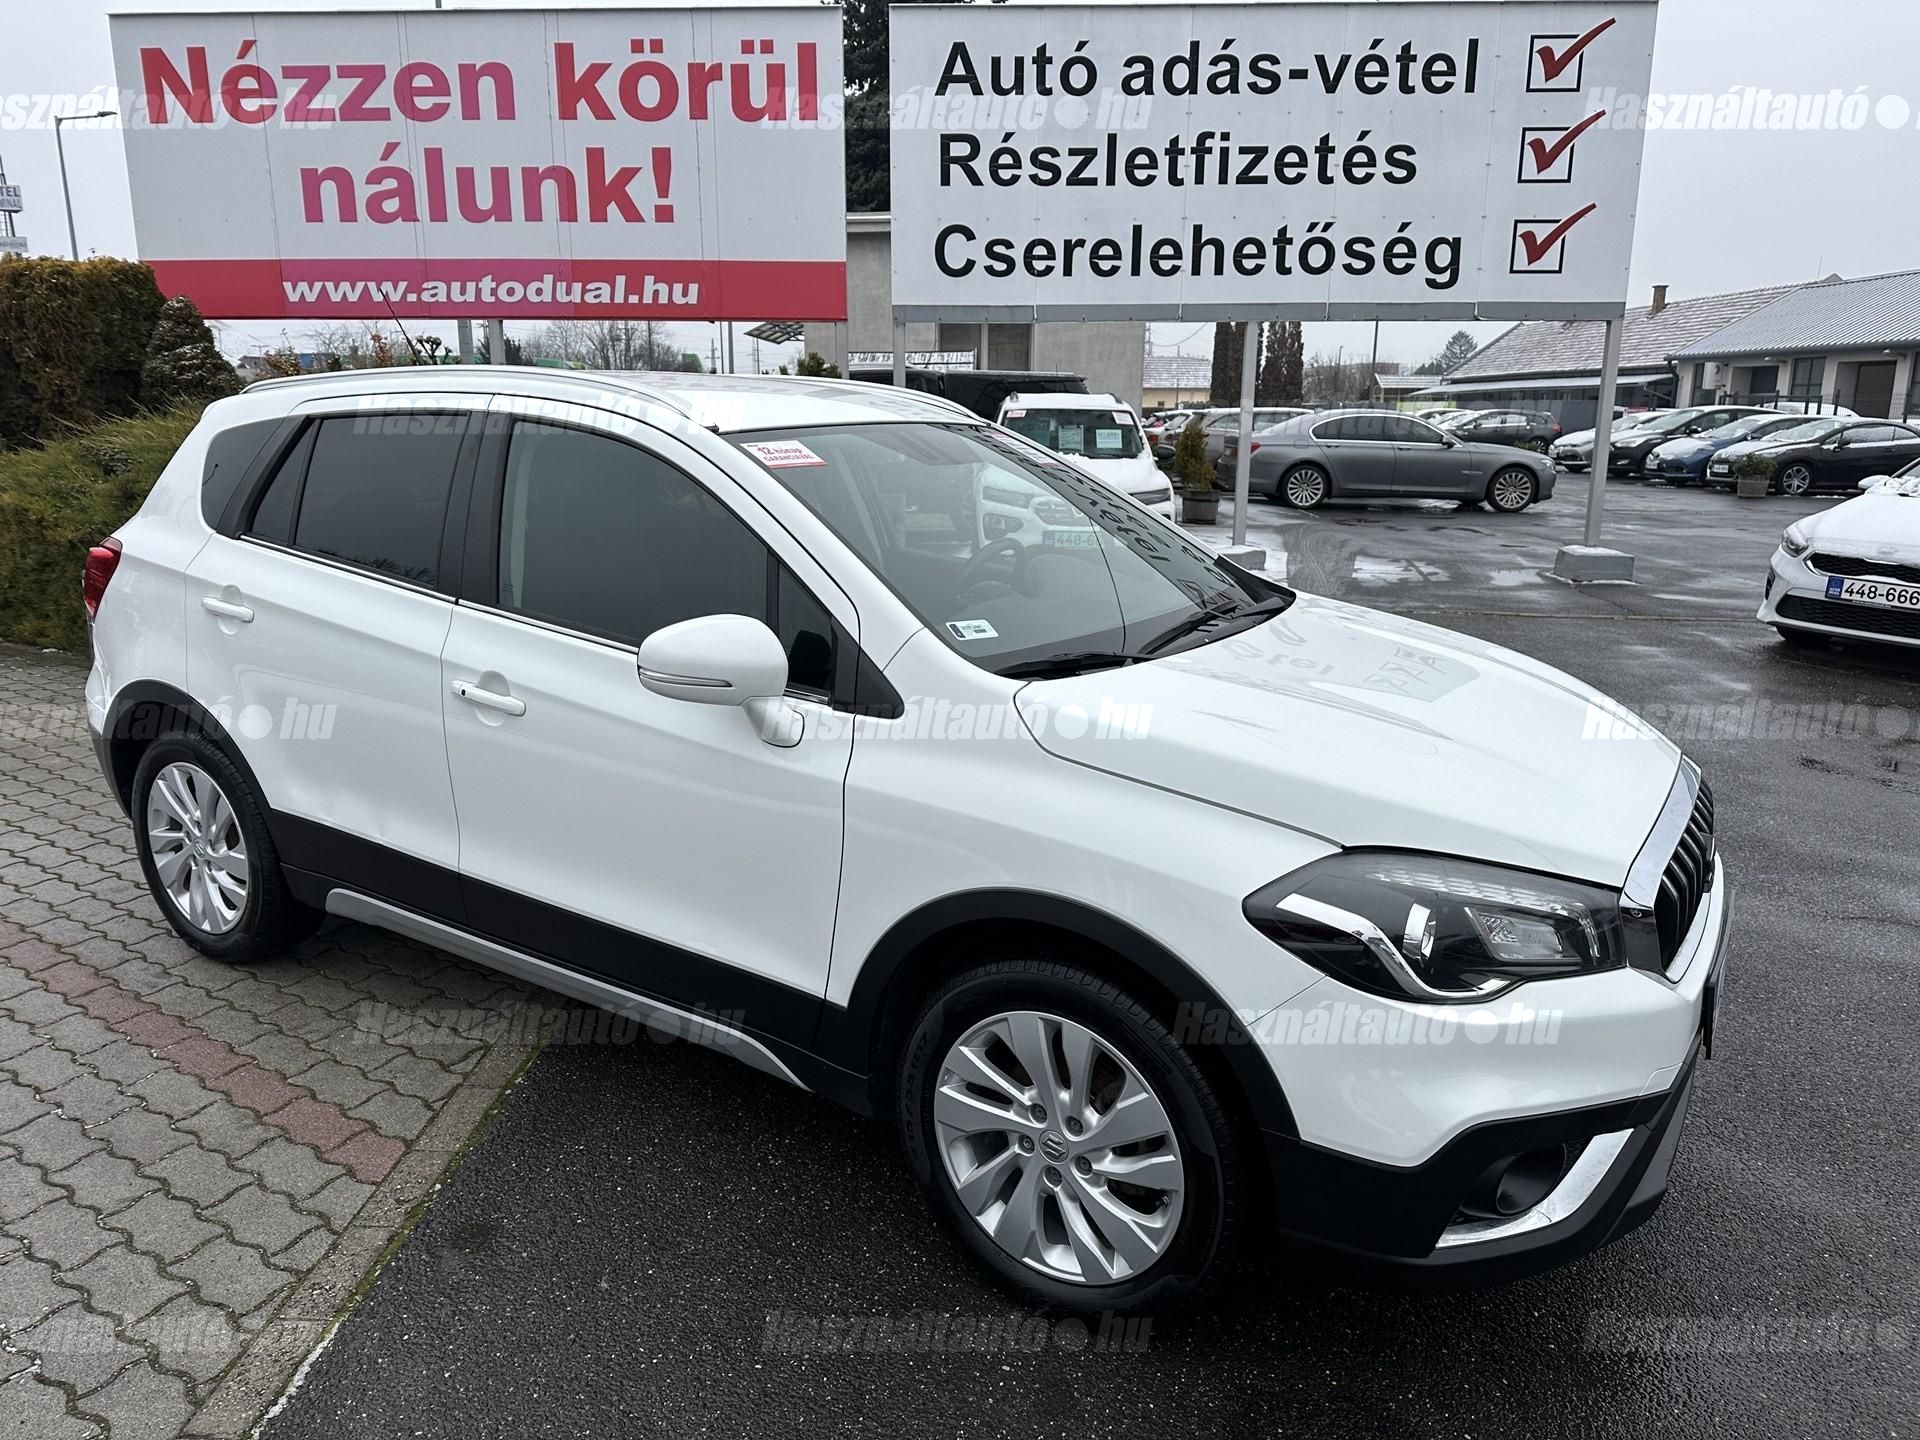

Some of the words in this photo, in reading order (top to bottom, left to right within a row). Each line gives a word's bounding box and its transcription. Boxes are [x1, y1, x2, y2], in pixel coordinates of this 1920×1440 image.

[140, 40, 516, 125] Nézzen
[554, 37, 819, 122] körül
[935, 40, 1098, 97] Autó
[1120, 37, 1480, 96] adás-vétel
[300, 141, 676, 224] nálunk!
[938, 130, 1418, 188] Részletfizetés
[934, 221, 1463, 290] Cserelehetőség
[282, 272, 701, 307] www.autodual.hu
[1844, 582, 1920, 606] 448-666
